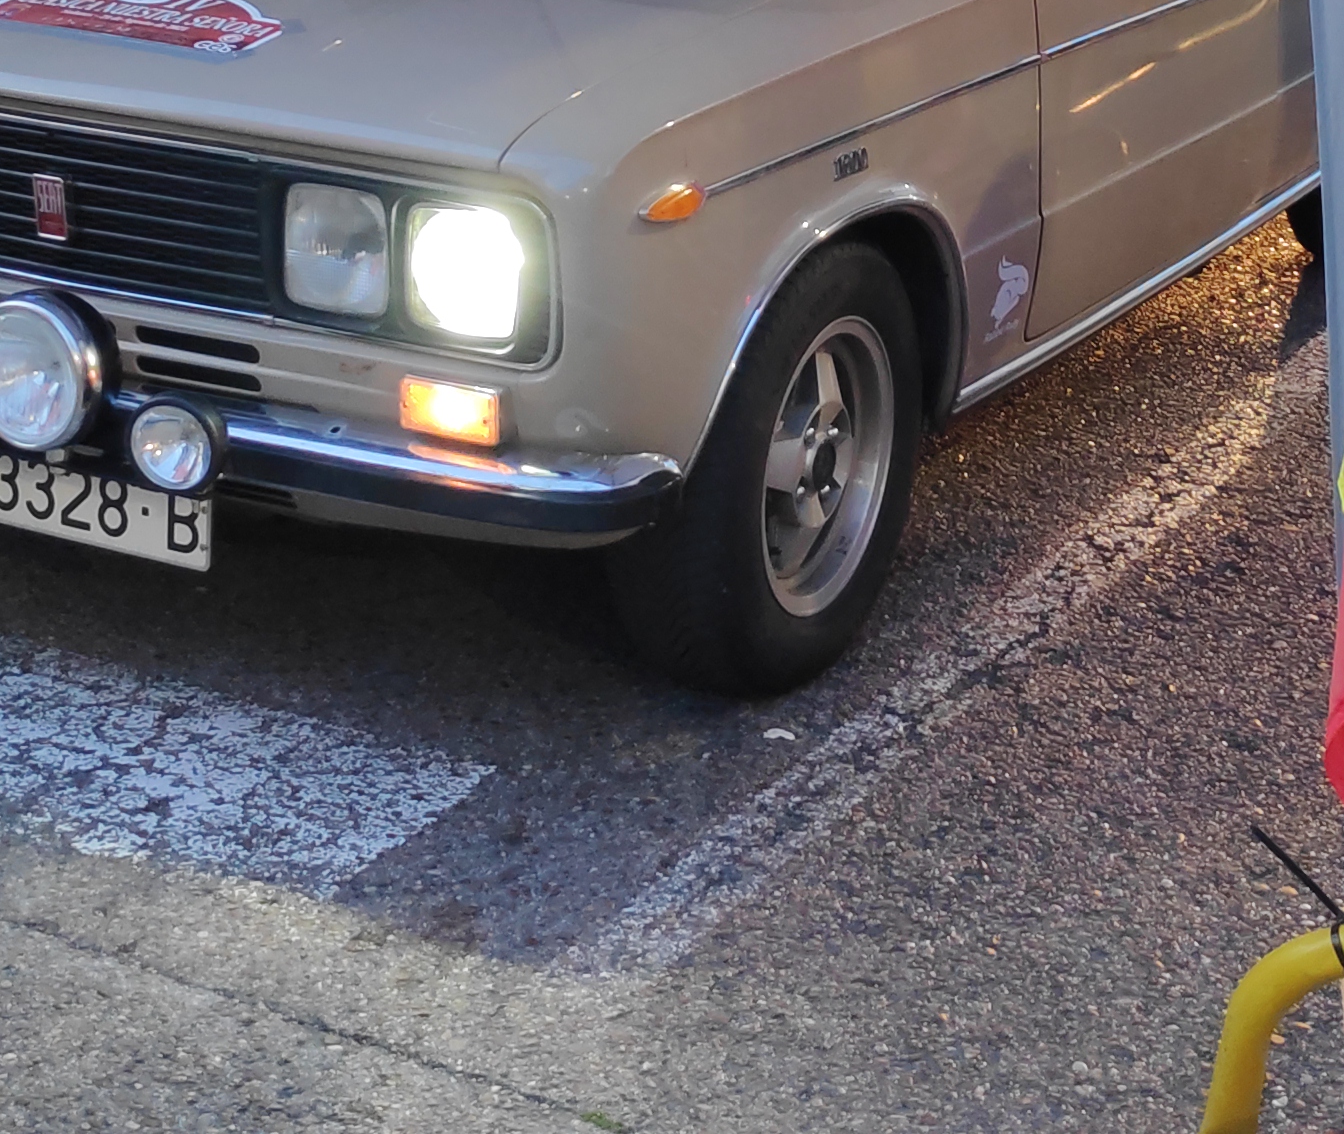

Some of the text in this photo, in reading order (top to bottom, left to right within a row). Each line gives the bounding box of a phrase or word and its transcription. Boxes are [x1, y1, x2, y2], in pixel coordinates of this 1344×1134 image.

[103, 2, 195, 27] NUESTRA
[192, 15, 275, 38] SEÑORA
[36, 180, 63, 215] SEAT
